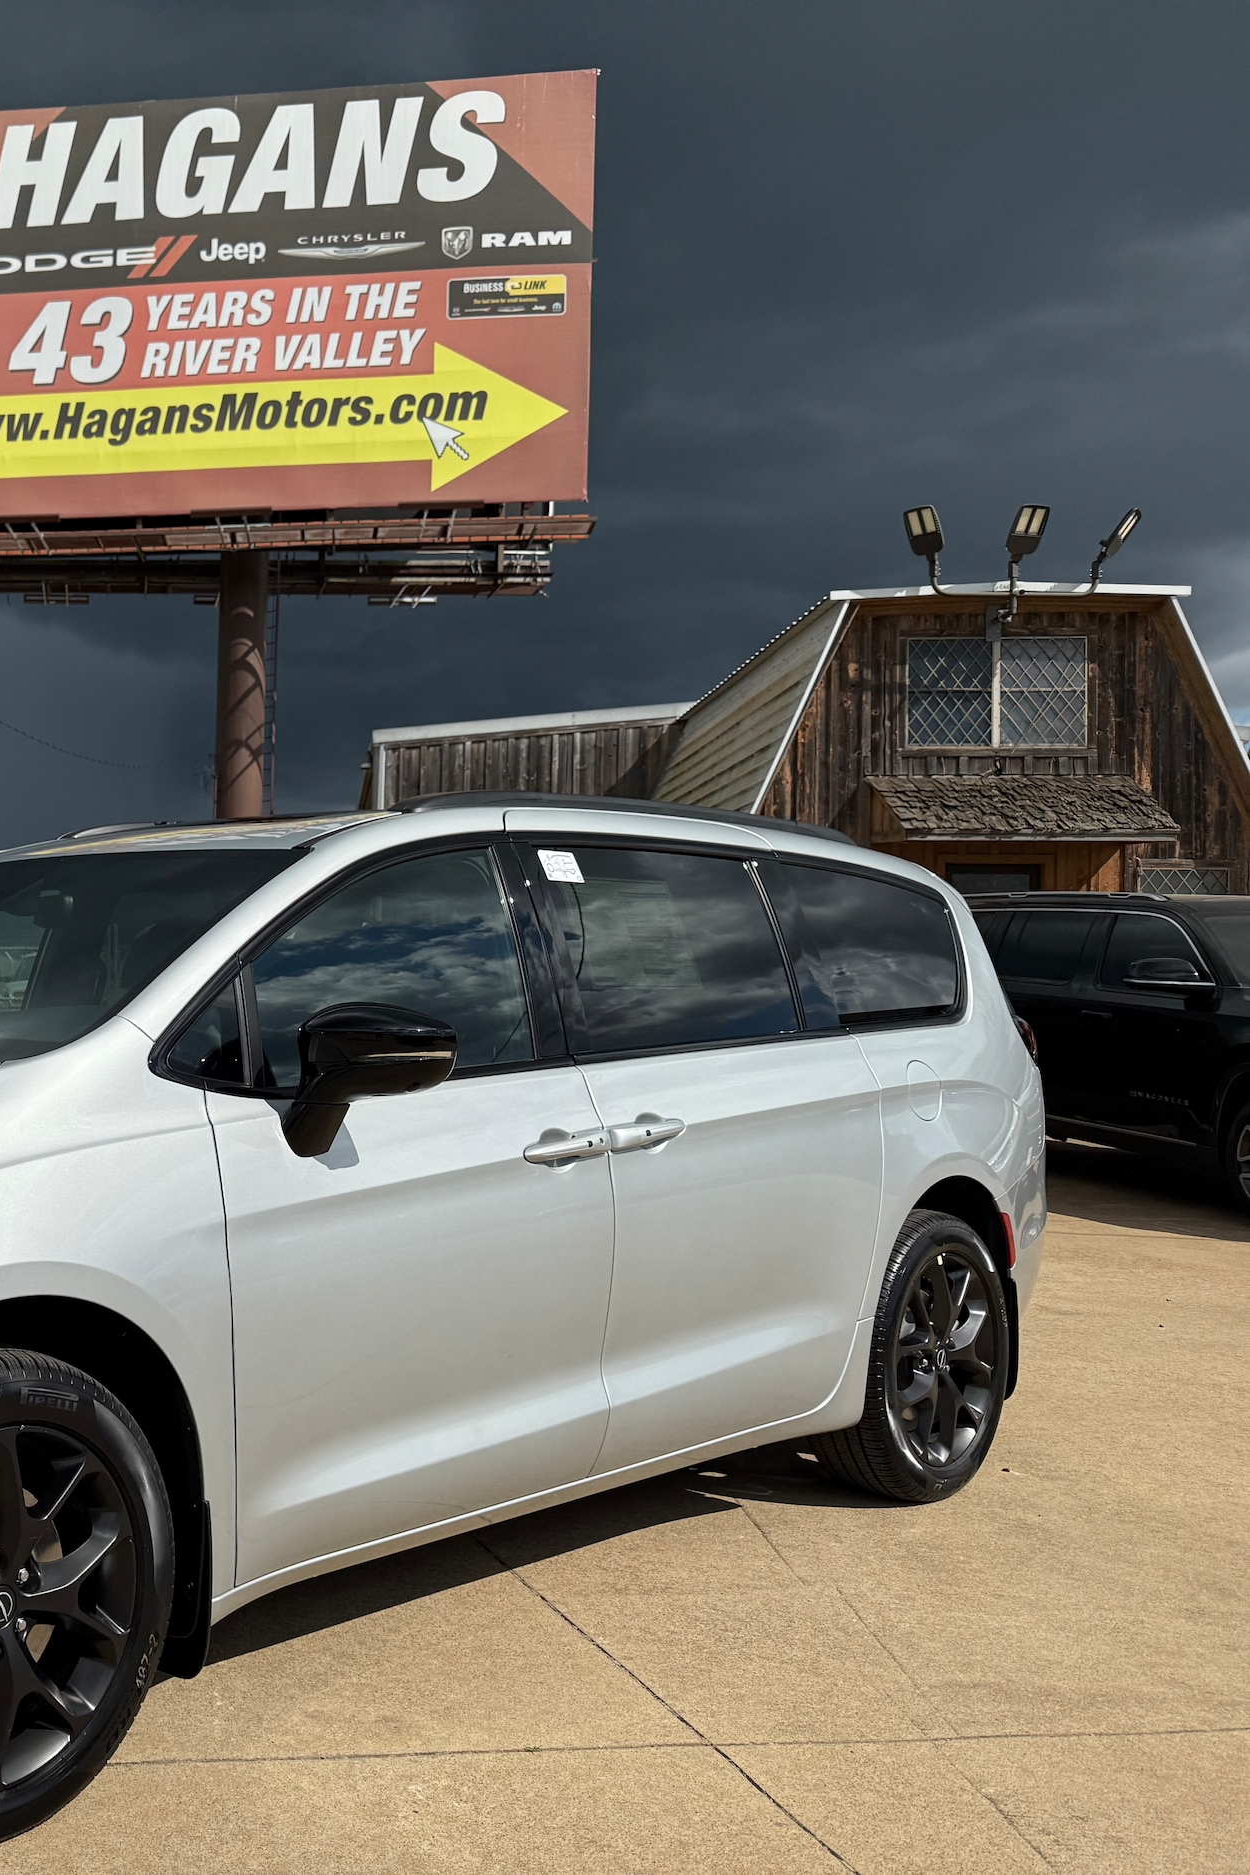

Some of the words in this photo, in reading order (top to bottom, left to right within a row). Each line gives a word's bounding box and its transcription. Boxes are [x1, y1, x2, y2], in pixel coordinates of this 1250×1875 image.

[296, 231, 406, 245] CHRYSLER
[481, 230, 572, 248] RAM
[200, 238, 266, 264] Jeep
[463, 282, 504, 294] BUSINESS
[523, 280, 548, 290] LINK
[146, 289, 275, 331] YEARS
[285, 286, 333, 324] IN
[345, 281, 423, 321] THE
[8, 296, 134, 387] 43
[140, 337, 262, 379] RIVER
[274, 328, 427, 372] VALLEY
[20, 1387, 79, 1412] PIRELLI
